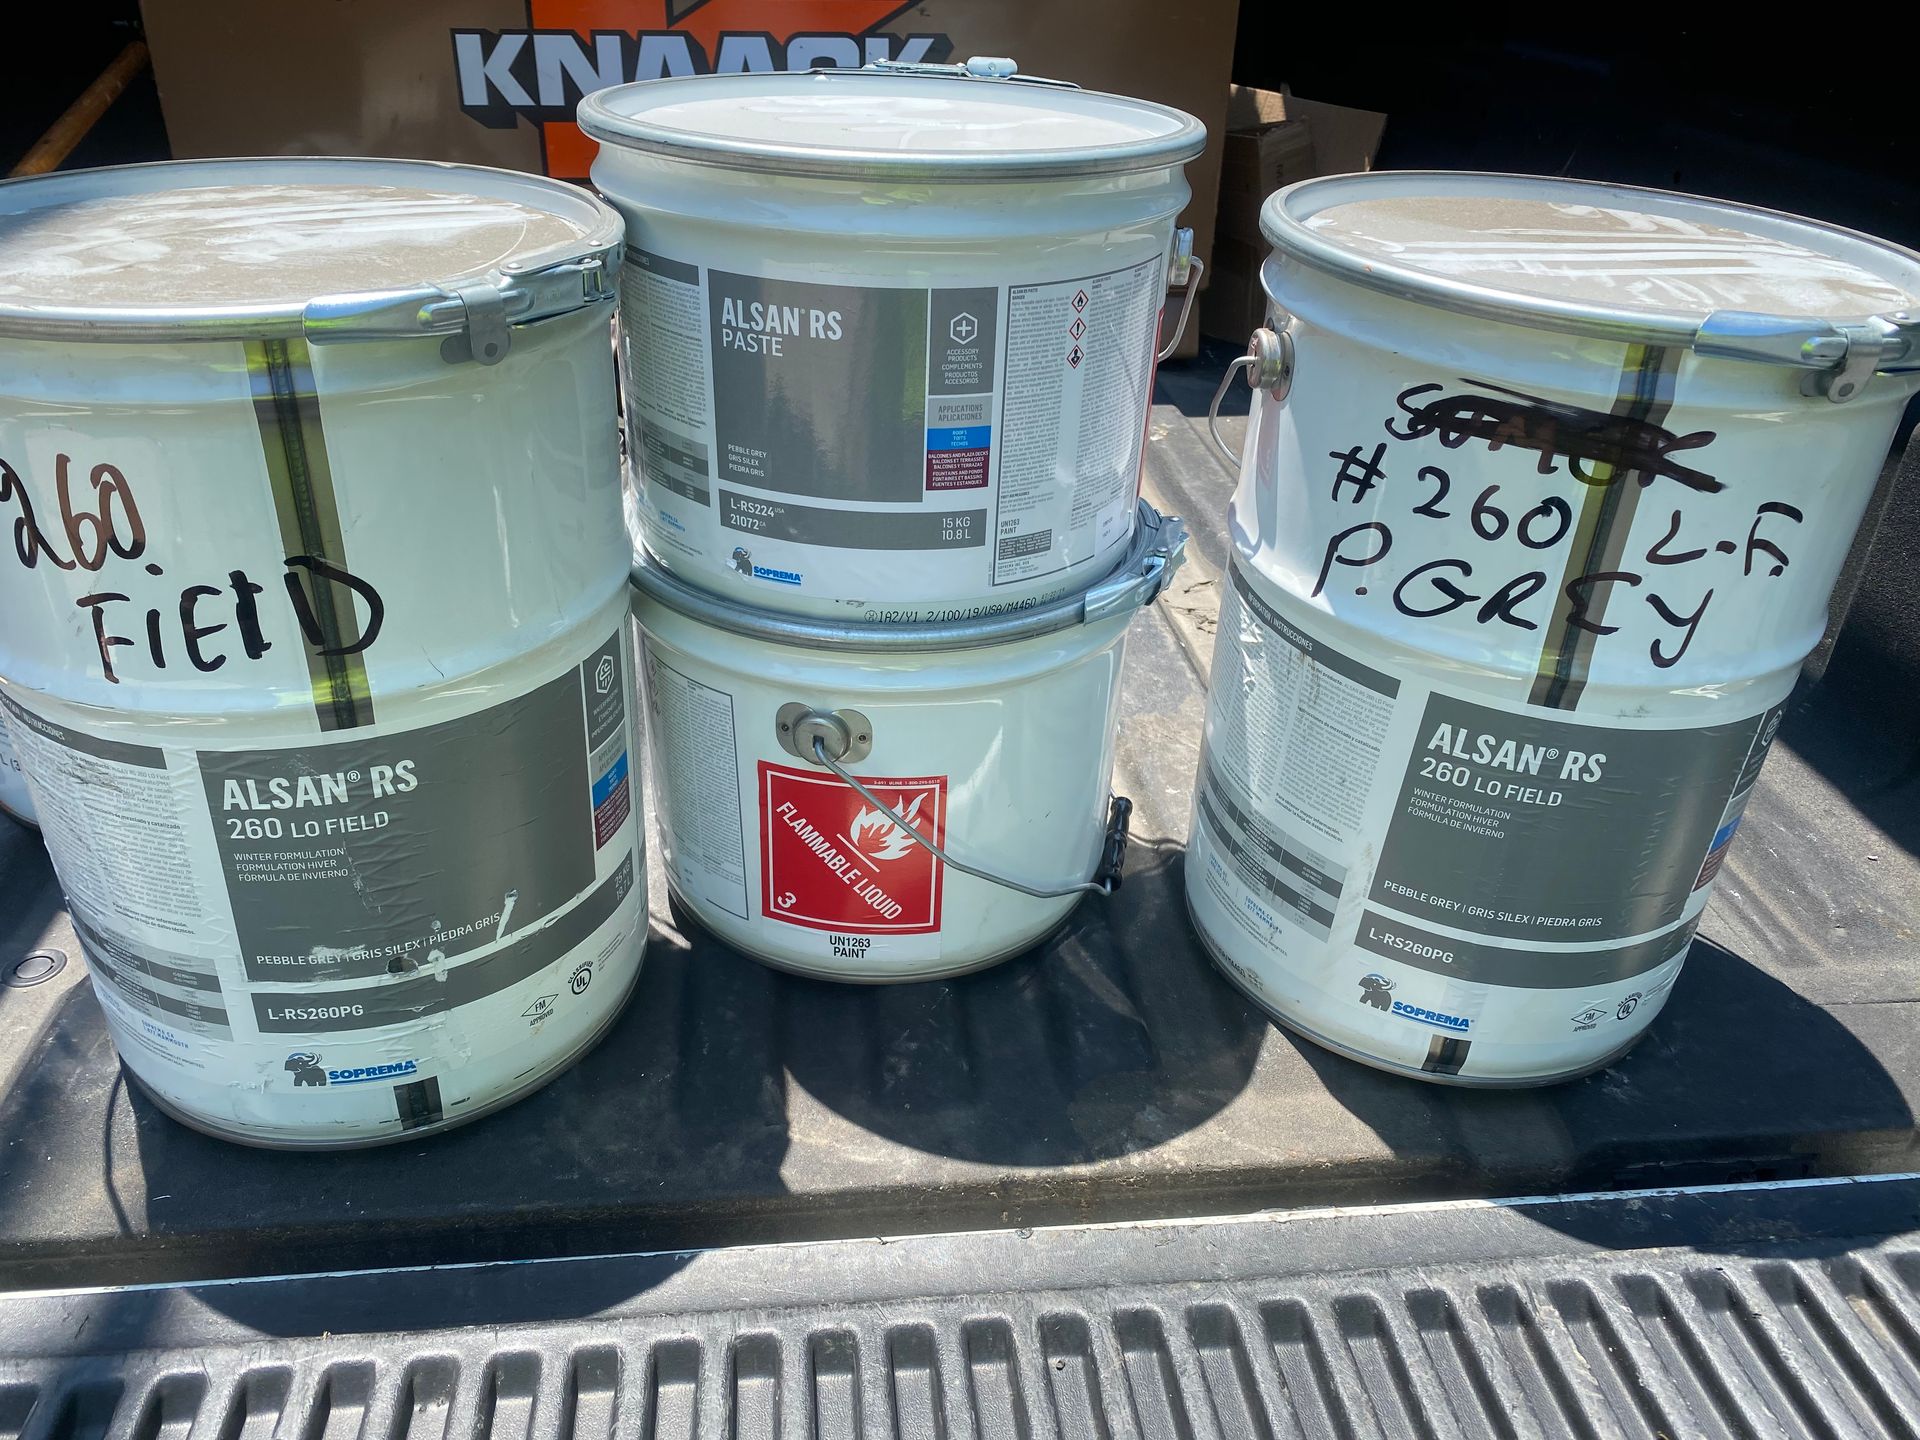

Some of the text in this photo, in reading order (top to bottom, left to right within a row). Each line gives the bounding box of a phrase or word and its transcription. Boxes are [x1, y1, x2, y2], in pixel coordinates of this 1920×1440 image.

[810, 309, 843, 341] RS
[722, 328, 783, 356] PASTE
[947, 348, 979, 356] ACCESSORY
[944, 377, 979, 385] ACCESORIOS
[938, 404, 983, 414] APPLICATIONS
[938, 412, 983, 422] APLICACIONES
[727, 443, 768, 459] PEBBLE GREY
[728, 453, 760, 467] GRIS SILEX
[728, 463, 765, 477] PIEDRA GRIS
[1412, 466, 1572, 549] 260
[942, 516, 971, 528] 15 KG
[1000, 527, 1017, 535] PAINT
[942, 529, 971, 540] 10.8 L
[1392, 558, 1714, 669] GREY
[1273, 616, 1313, 651] INSTRUCCIONES
[1559, 750, 1607, 783] RS
[369, 759, 418, 799] RS
[1419, 756, 1563, 807] 260 LO FIELD
[1410, 796, 1500, 828] FORMULATION HIVER
[1413, 787, 1511, 821] WINTER FORMULATION
[226, 811, 389, 840] 260 LO FIELD
[1407, 805, 1505, 839] FÓRMULA DE INVIERNO
[233, 848, 344, 862] WINTER FORMULATION
[776, 801, 902, 920] FLAMMABLE LIQUID
[236, 859, 337, 872] FORMULATION HIVER
[614, 861, 631, 888] 25 KG
[238, 868, 349, 882] FÓRMULA DE INVIERNO
[777, 891, 797, 908] 3
[1383, 880, 1603, 927] PEBBLE GREY GRIS SILEX PIEDRA GRIS
[256, 912, 500, 965] PEBBLE GREY GRIS SILEX PIEDRA GRIS
[829, 935, 871, 948] UN1263
[1368, 927, 1454, 964] L-RS260PG
[833, 946, 867, 959] PAINT
[575, 974, 587, 989] UL
[268, 1004, 364, 1020] L-RS260PG
[534, 999, 546, 1013] FM
[1392, 1001, 1470, 1028] SOPREMA
[529, 1008, 554, 1027] APPROVED
[1583, 1012, 1595, 1021] FM
[328, 1060, 417, 1080] SOPREMA
